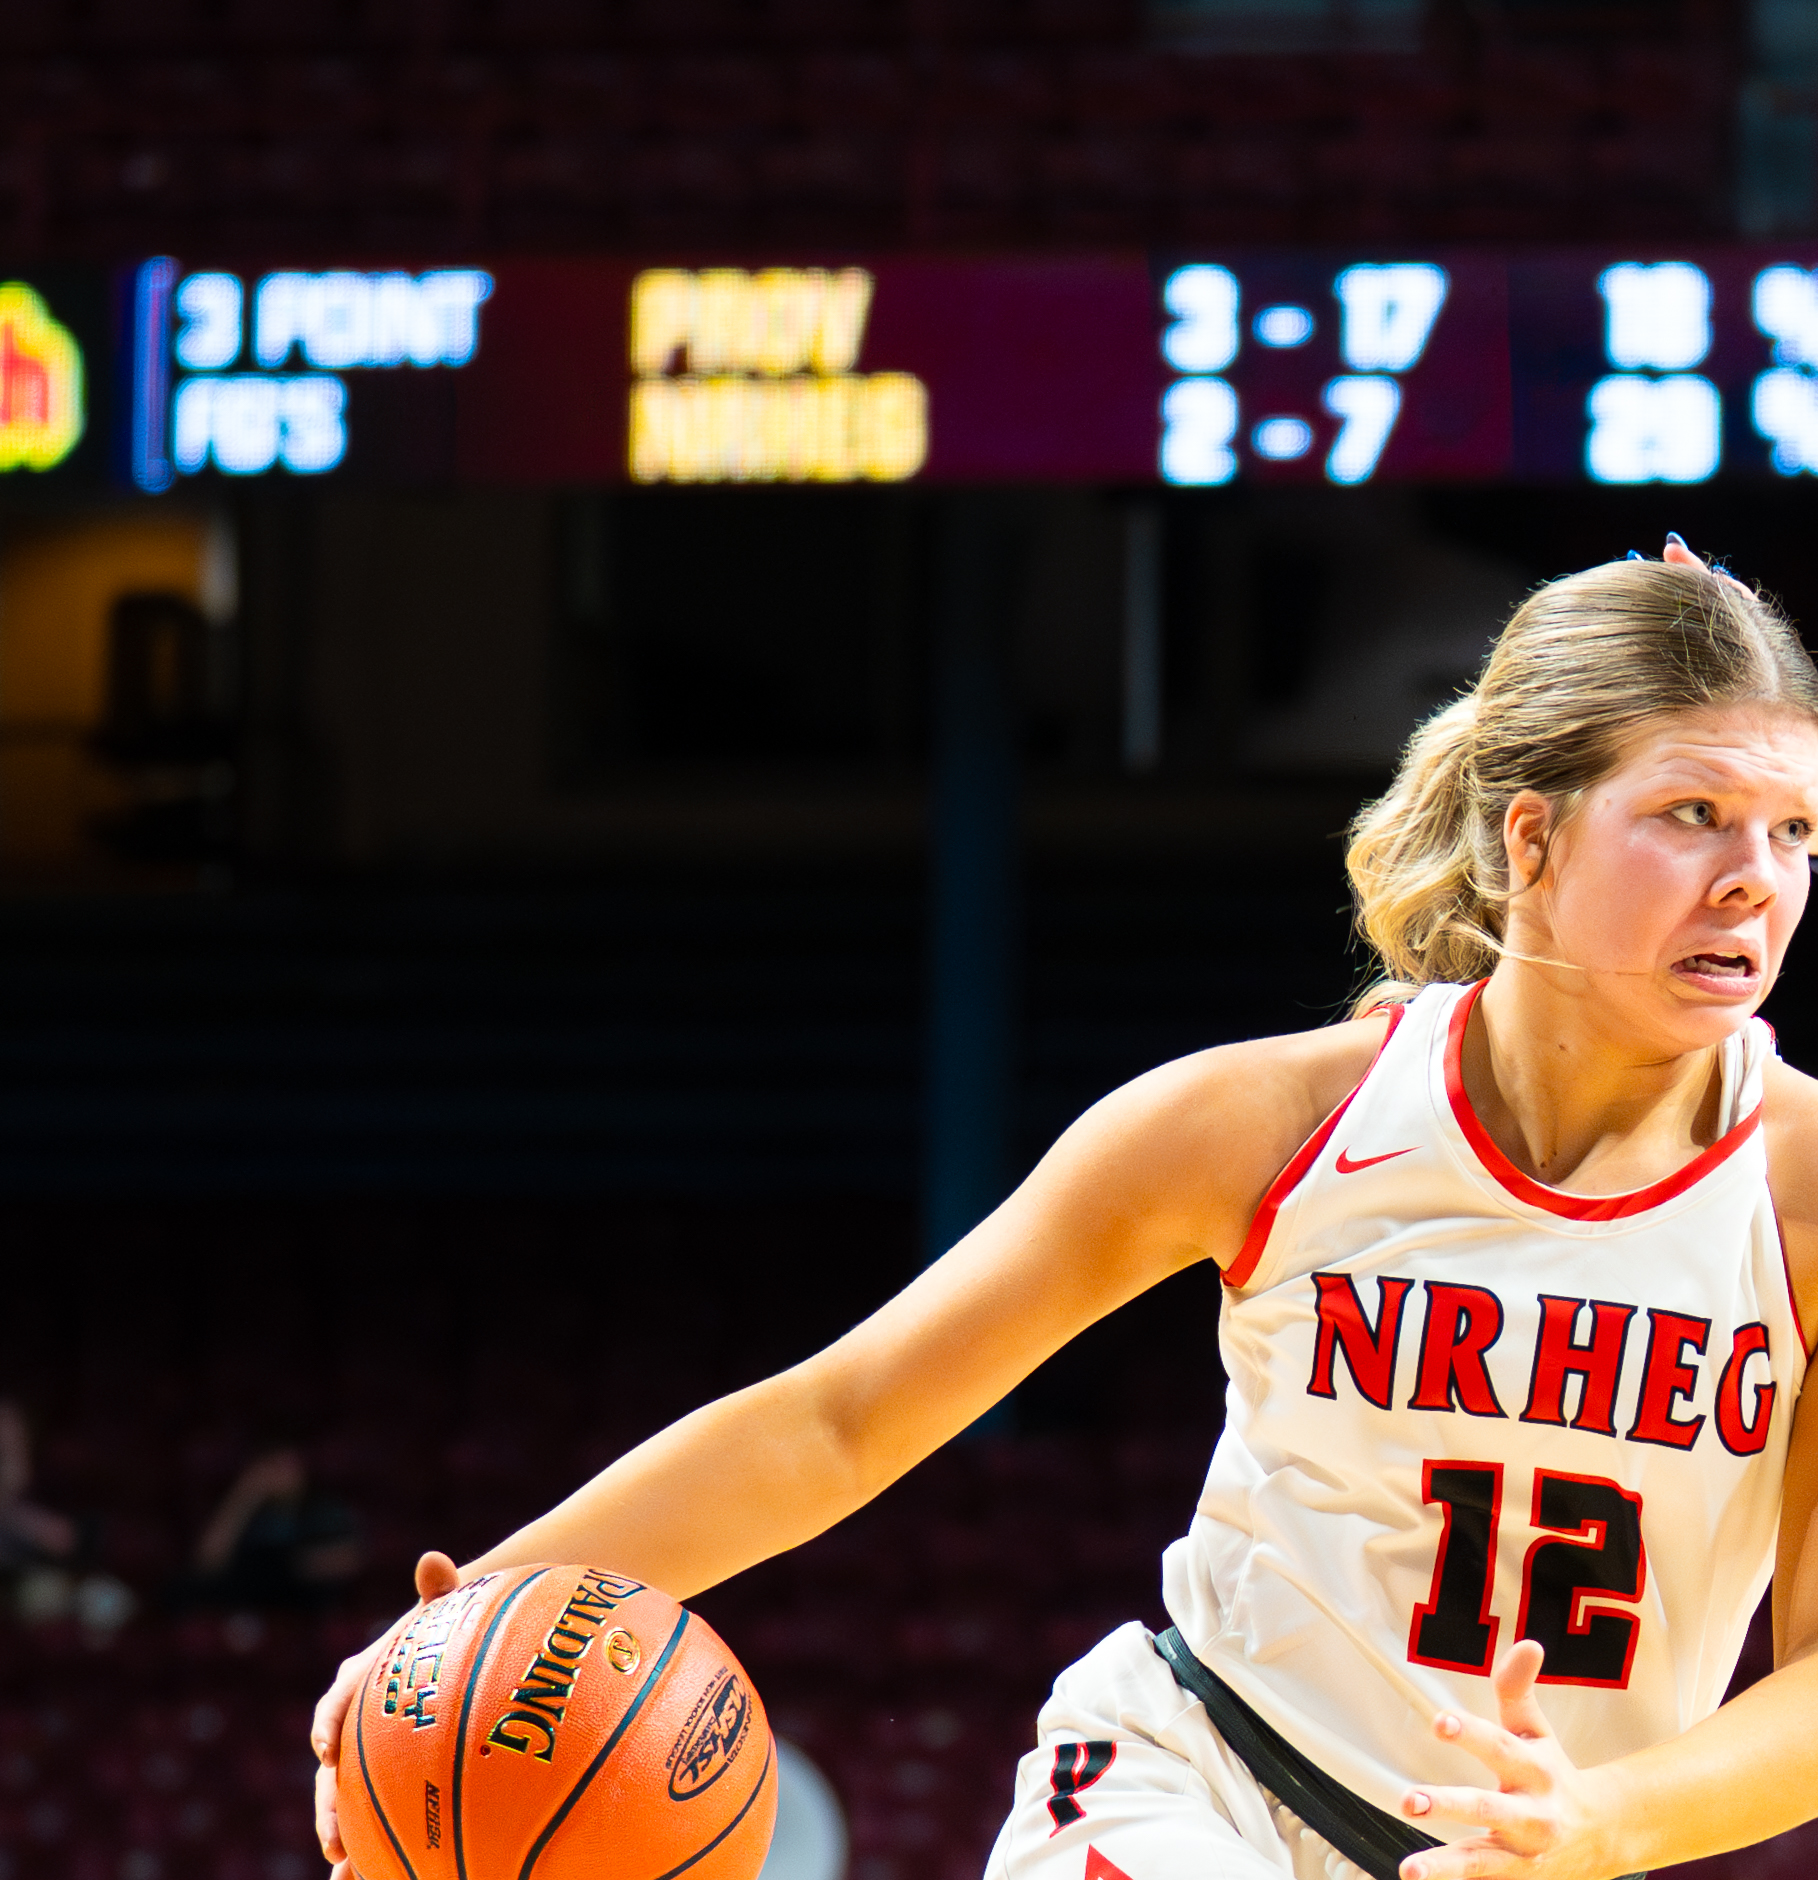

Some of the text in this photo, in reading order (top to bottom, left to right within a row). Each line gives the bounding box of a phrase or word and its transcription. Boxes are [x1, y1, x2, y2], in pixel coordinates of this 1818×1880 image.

[178, 270, 494, 368] 3 POINT
[630, 267, 873, 373] PROV
[1162, 264, 1239, 372] 3
[1334, 264, 1447, 372] 17
[1159, 375, 1239, 486] 2
[1323, 373, 1400, 484] 7
[1307, 1272, 1776, 1457] NRHEG
[1407, 1459, 1647, 1690] 12
[487, 1568, 648, 1764] PALDING
